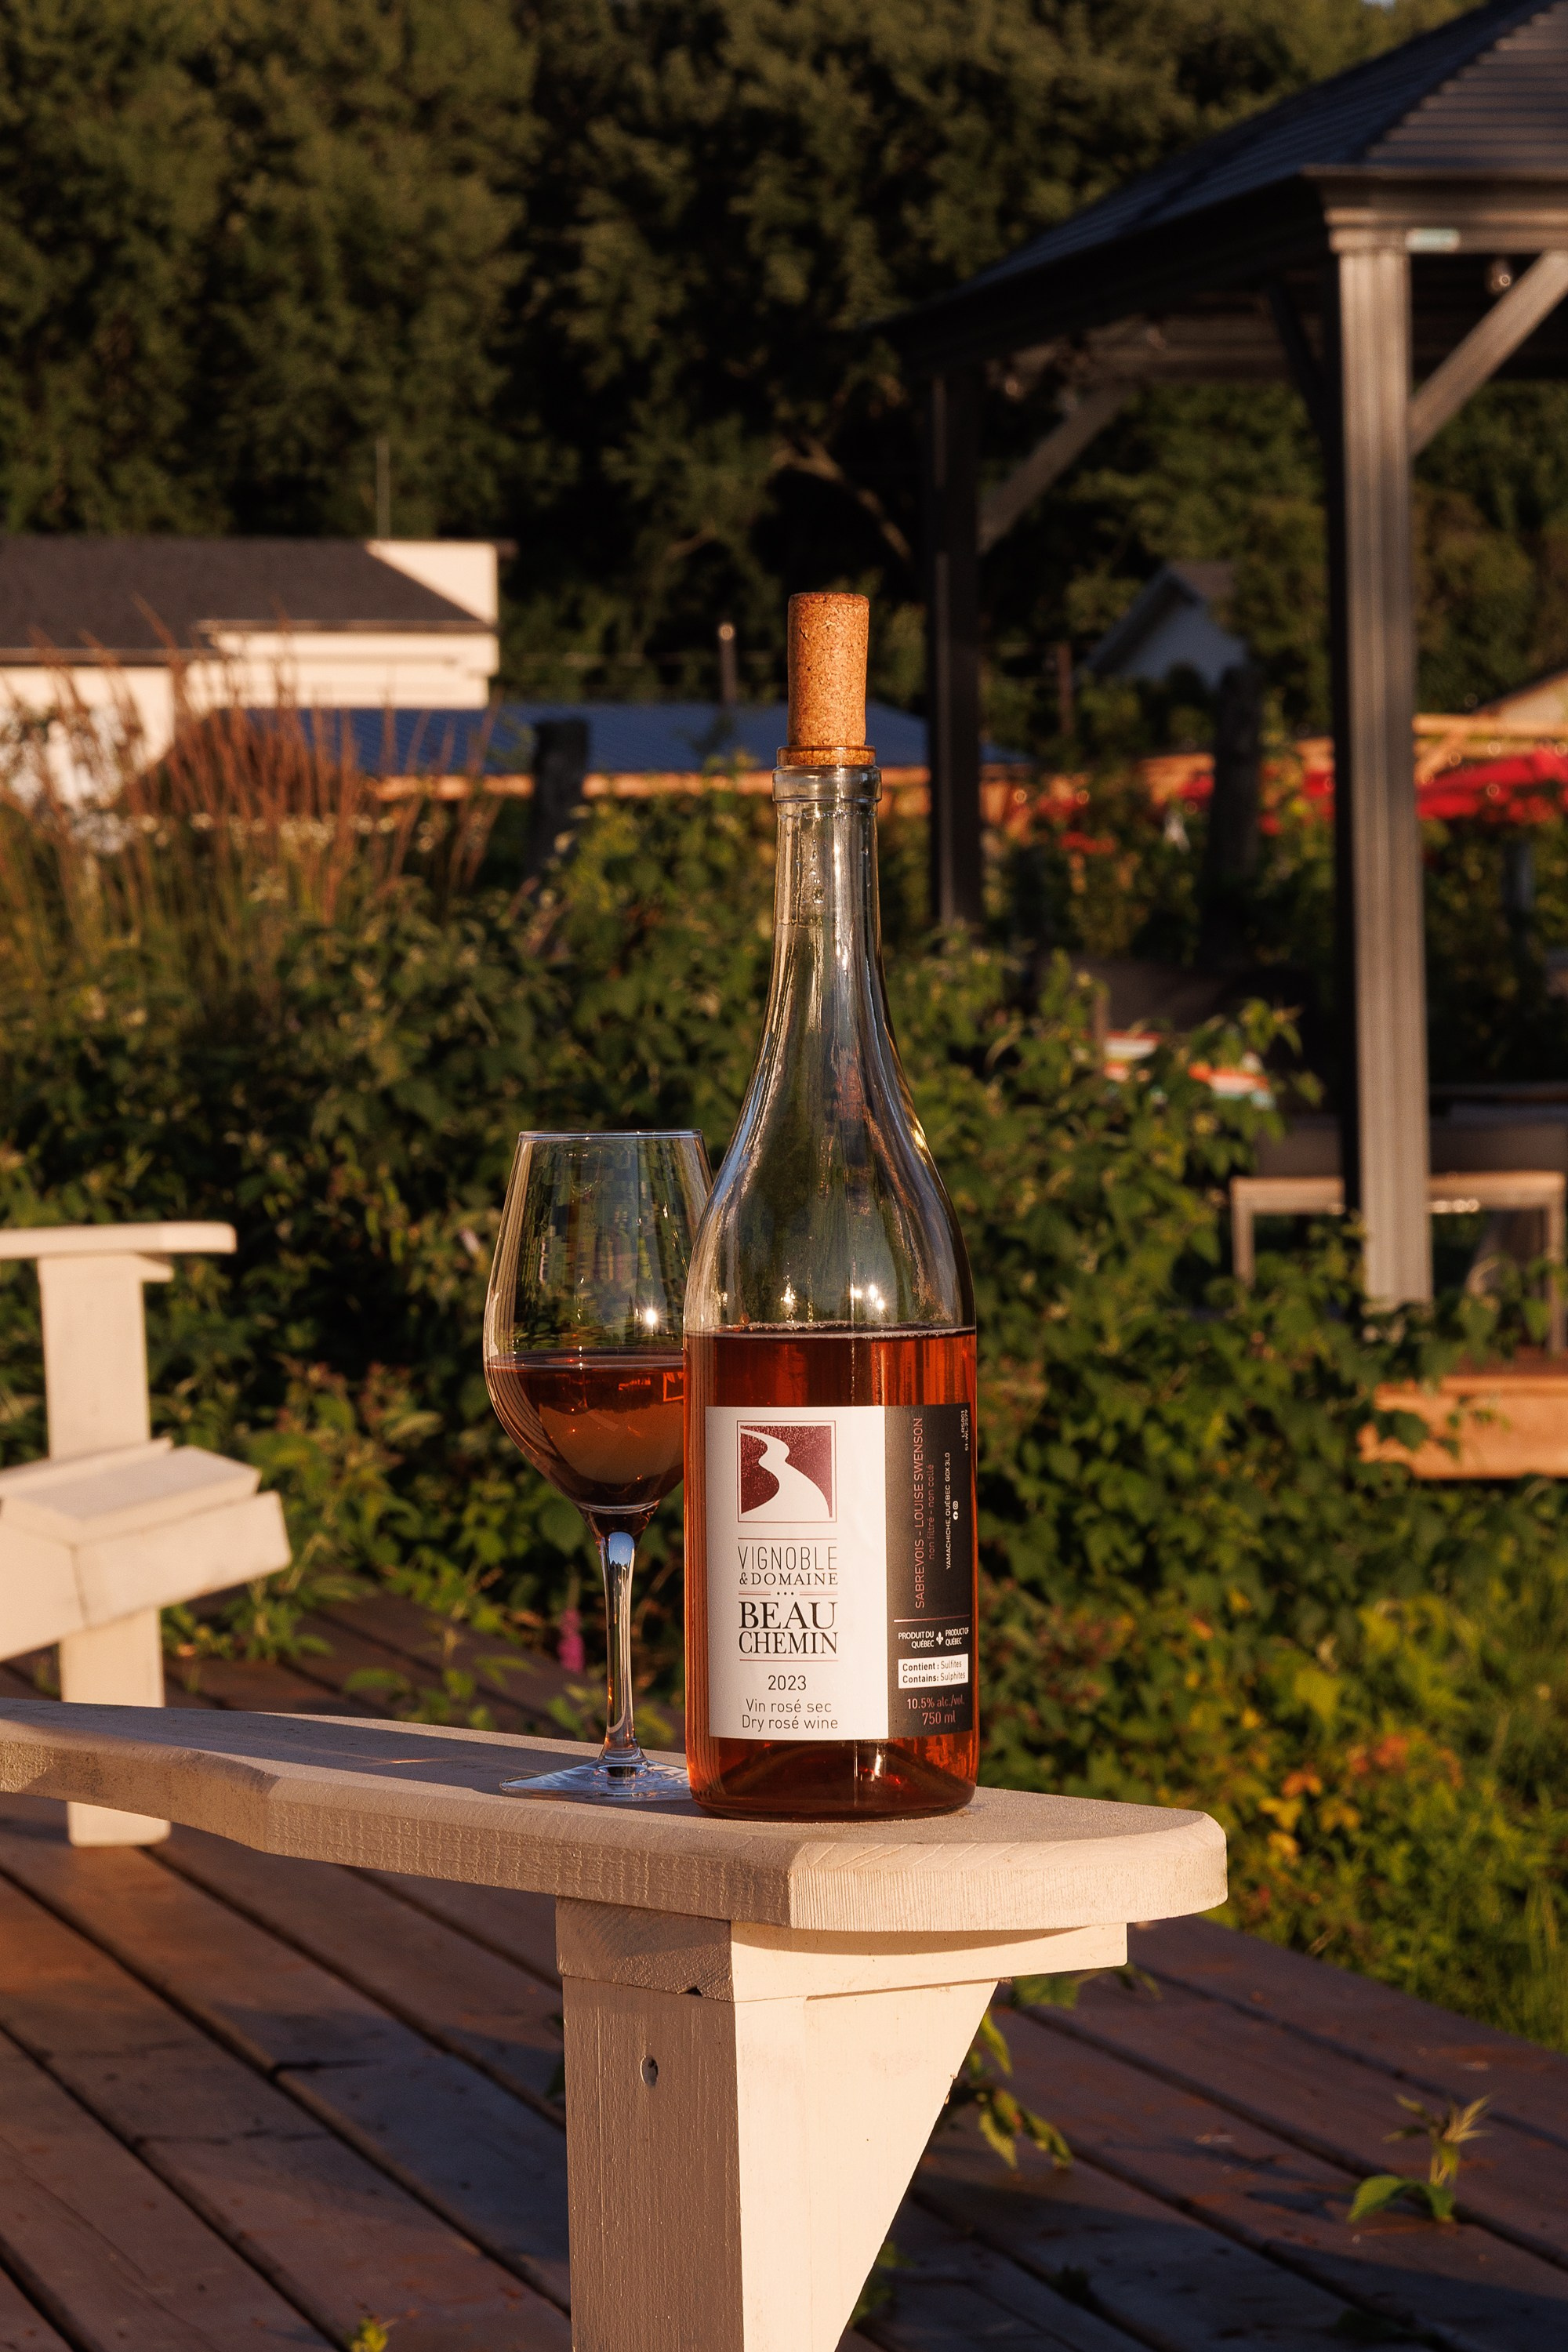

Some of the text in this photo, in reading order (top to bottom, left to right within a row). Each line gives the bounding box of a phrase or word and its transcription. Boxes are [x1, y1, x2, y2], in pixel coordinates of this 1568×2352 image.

[913, 1418, 924, 1481] SWENSON
[926, 1464, 935, 1486] collé
[913, 1484, 924, 1527] LOUISE
[738, 1546, 837, 1570] VIGNOBLE
[915, 1540, 925, 1609] SABREVOIS
[739, 1601, 837, 1629] BEAU
[898, 1632, 926, 1640] PRODUIT
[946, 1628, 964, 1636] PRODUCT
[739, 1632, 837, 1654] CHEMIN
[912, 1639, 934, 1648] QUÉBEC
[946, 1637, 962, 1646] QUÉBEC
[902, 1662, 935, 1671] Contient
[941, 1660, 962, 1669] Sulfites
[768, 1675, 807, 1691] 2023
[902, 1672, 965, 1683] Contains: Sulphites
[746, 1699, 832, 1713] Vin rosé sec
[907, 1694, 965, 1709] 10.5% alc./vol.
[742, 1715, 838, 1732] Dry rosé wine
[923, 1710, 956, 1726] 750 ml
